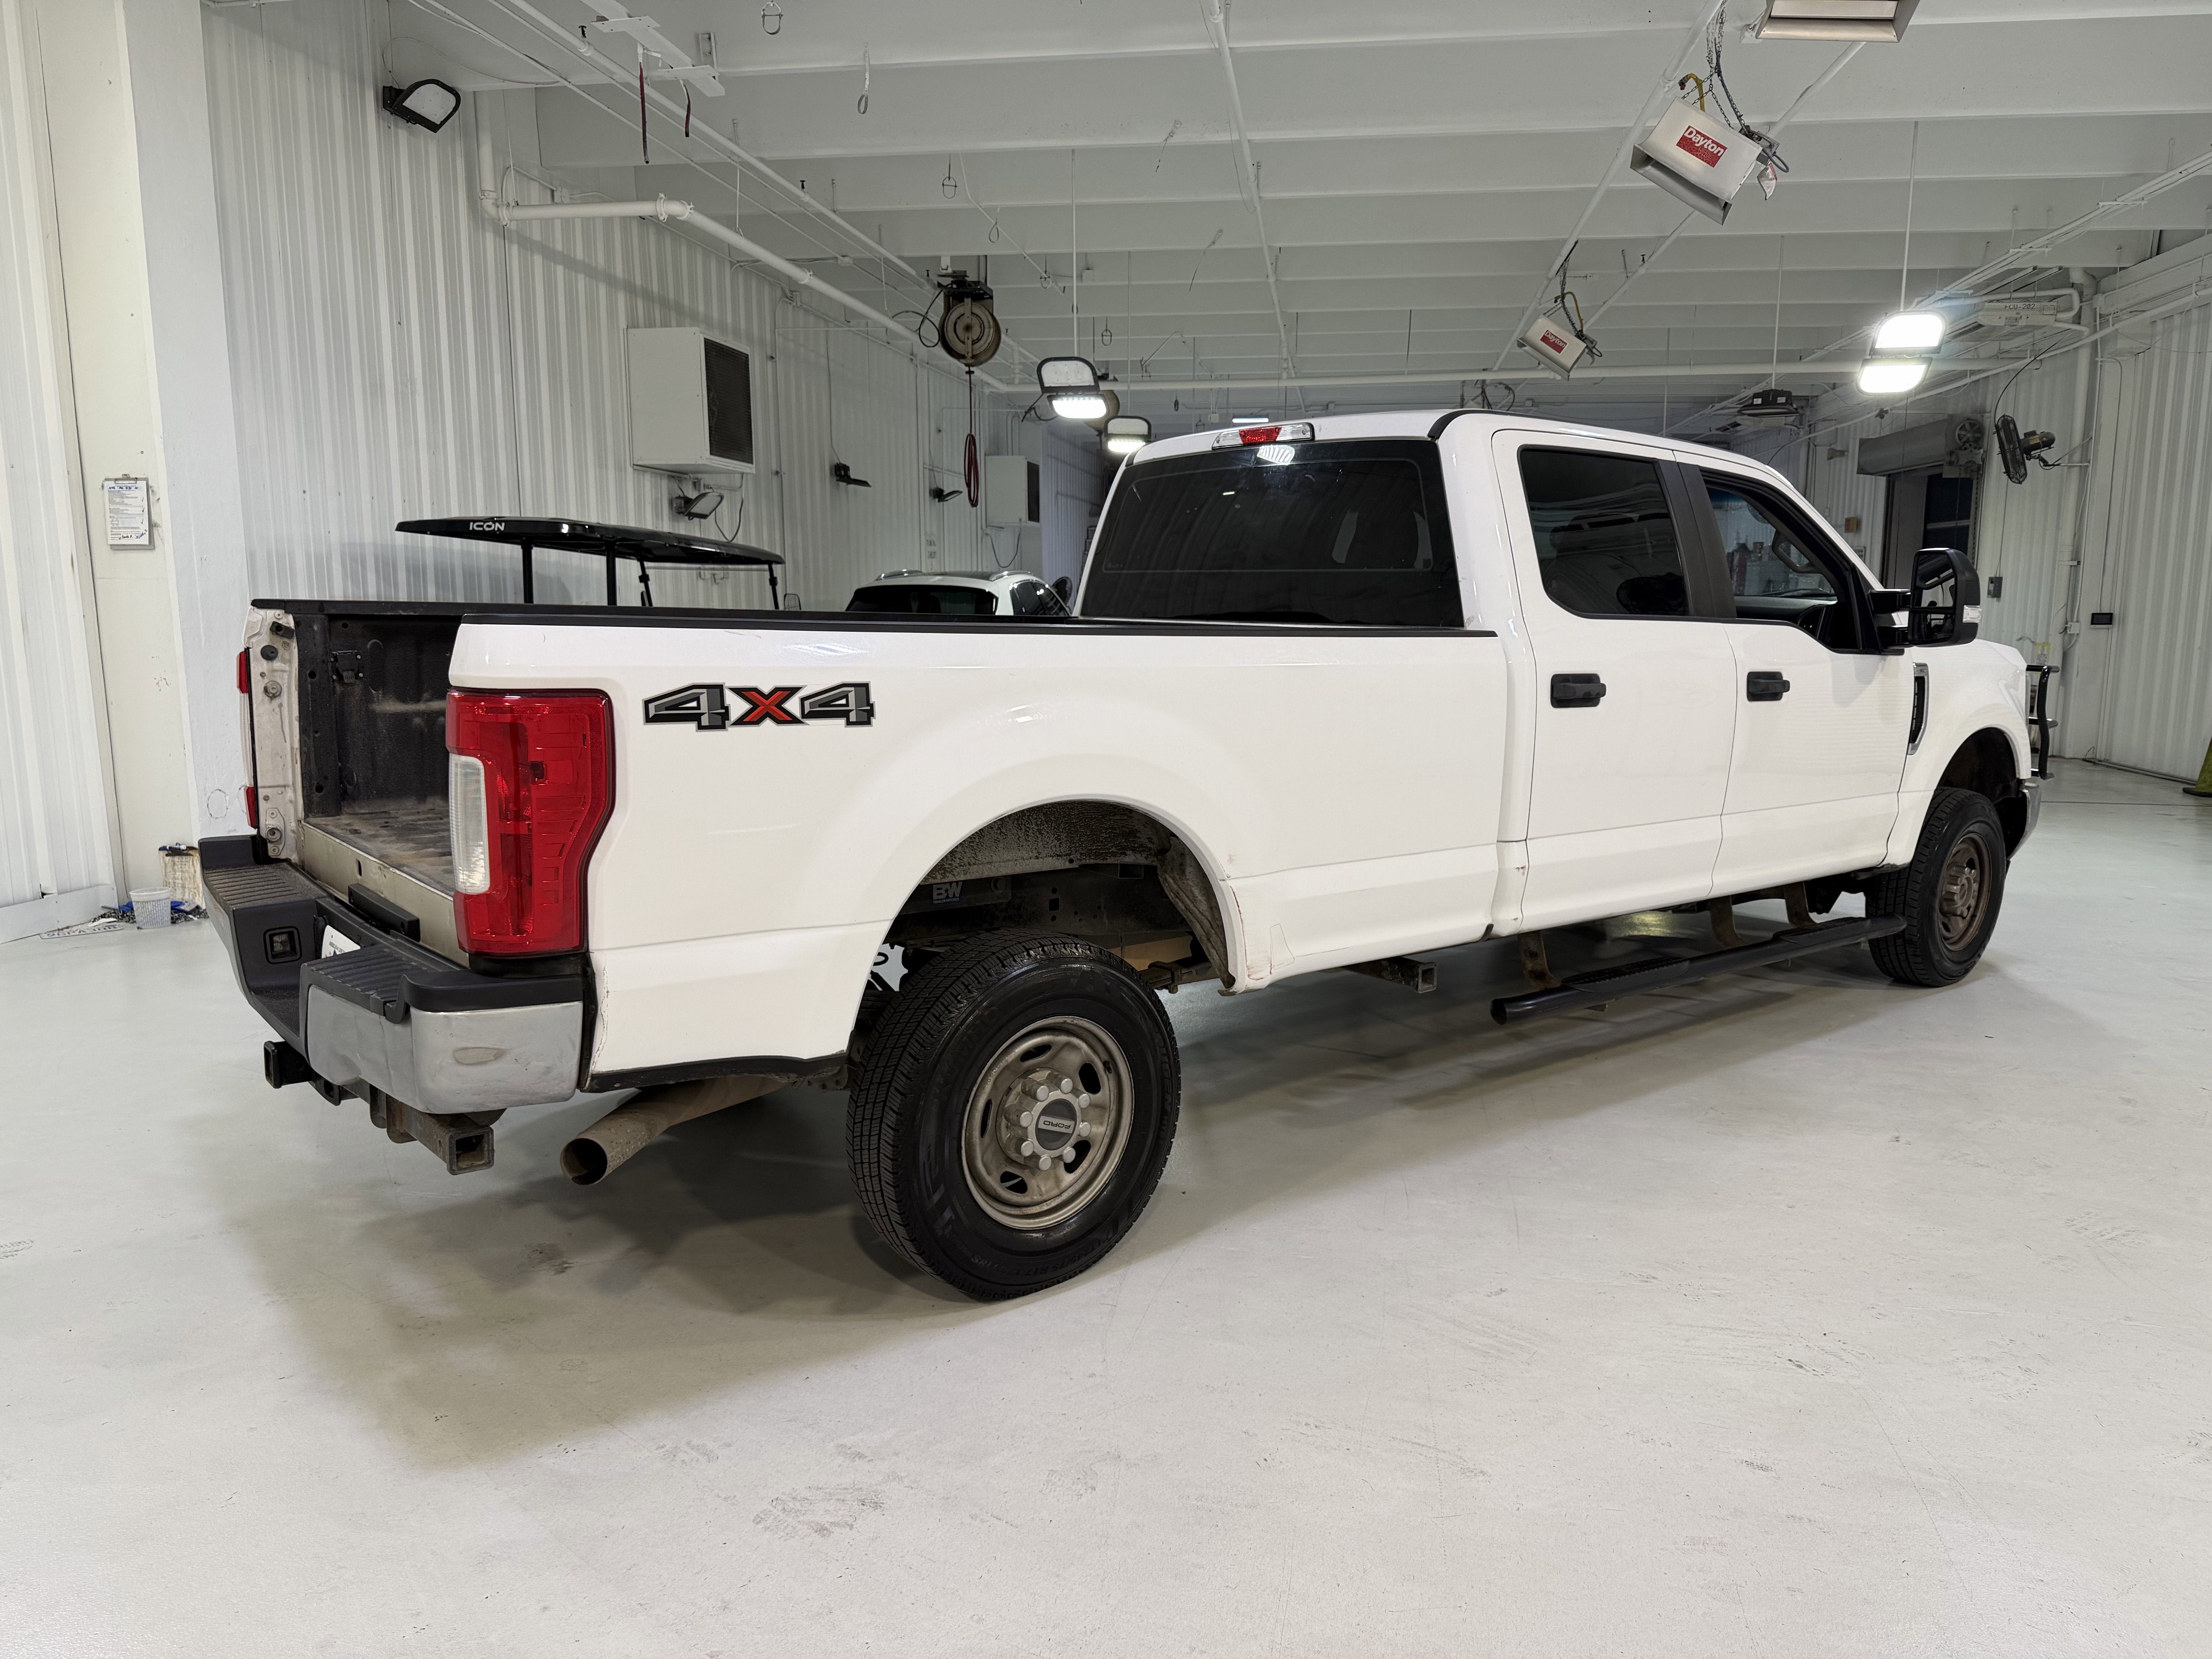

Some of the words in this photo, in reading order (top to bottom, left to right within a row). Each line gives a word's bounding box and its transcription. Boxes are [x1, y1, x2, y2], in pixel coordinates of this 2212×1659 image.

[1684, 127, 1724, 156] Dayton
[1544, 331, 1566, 348] Dayton
[469, 522, 505, 531] ICON
[642, 681, 876, 732] 4X4
[1043, 1120, 1071, 1129] FORD
